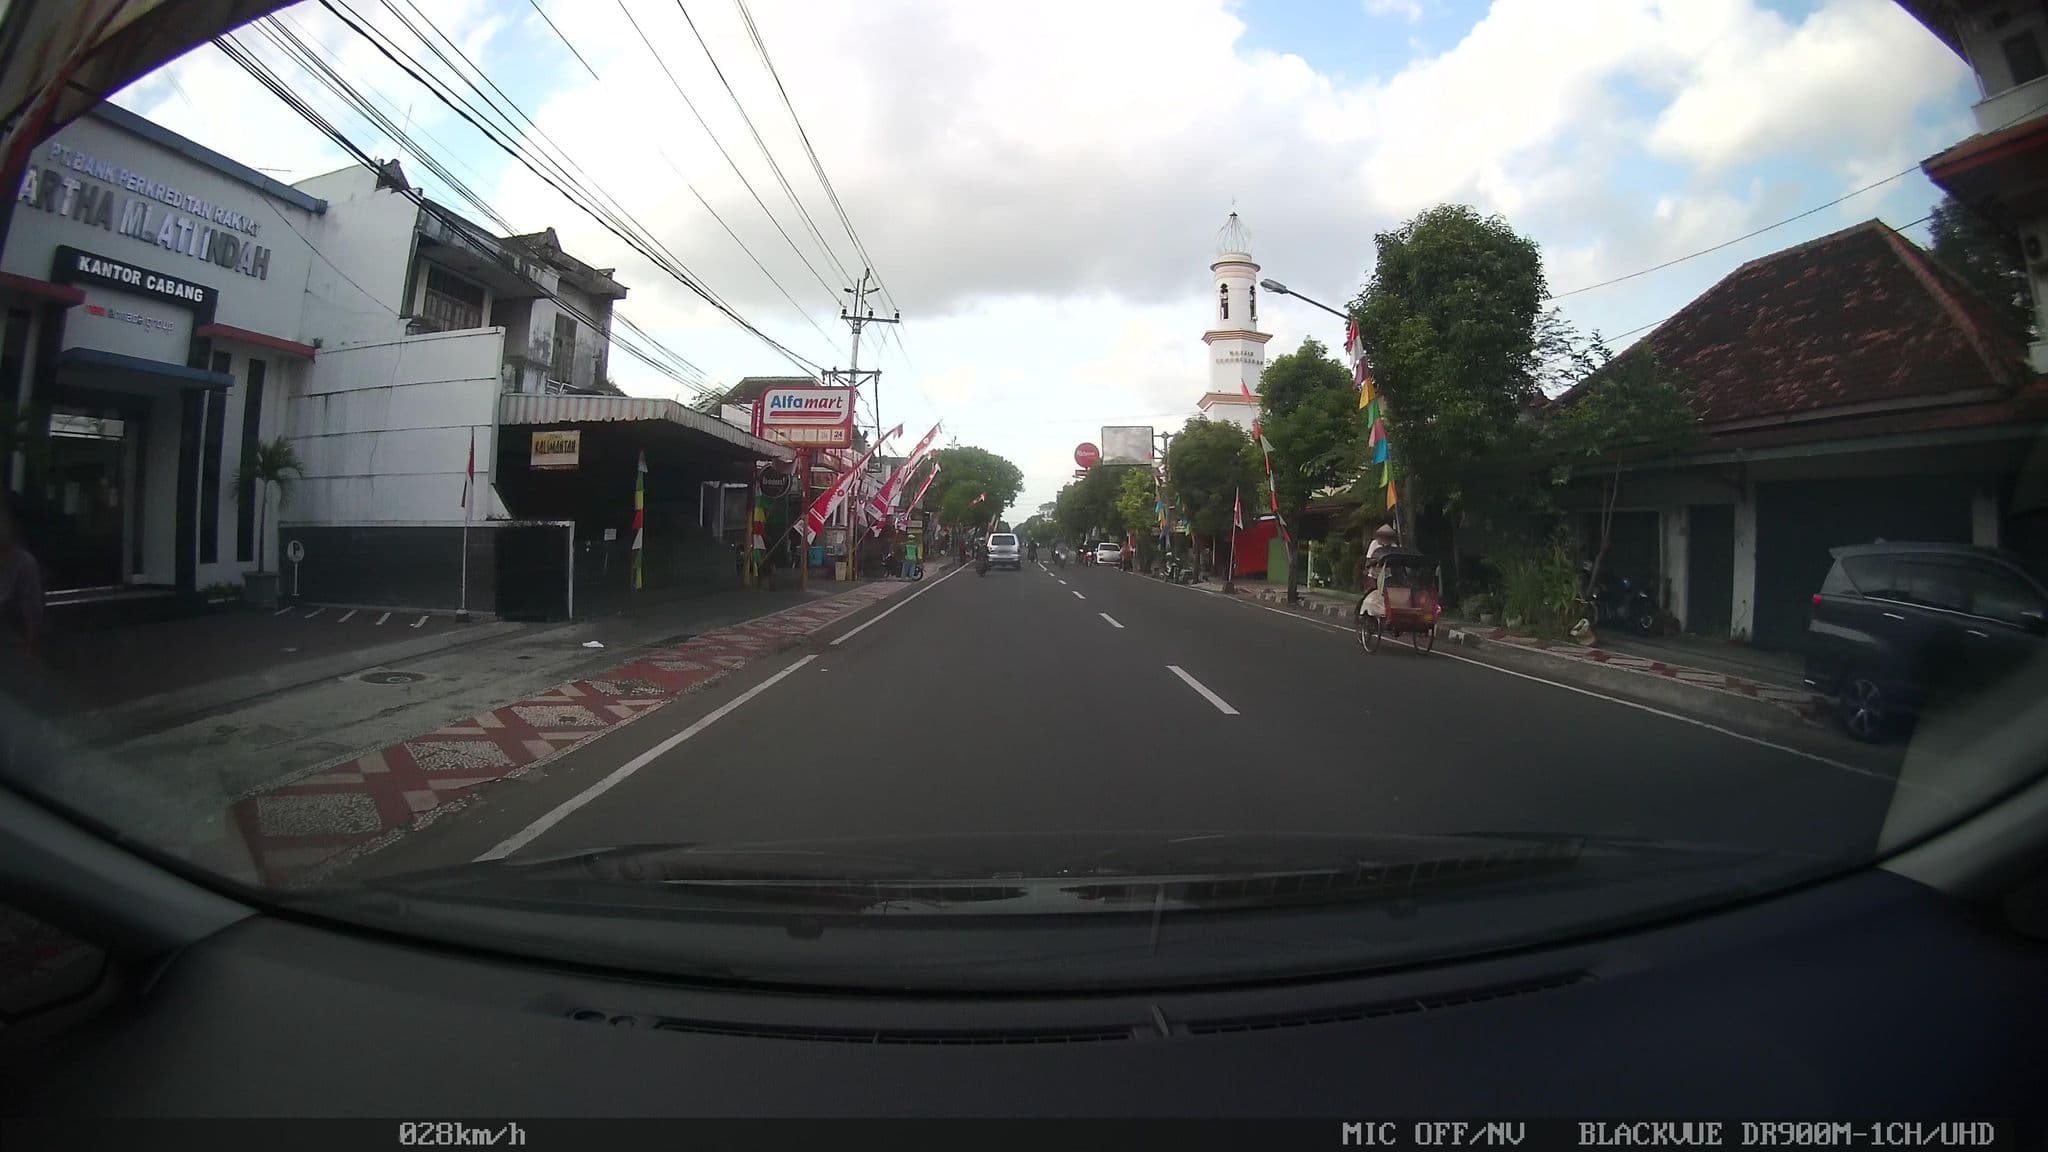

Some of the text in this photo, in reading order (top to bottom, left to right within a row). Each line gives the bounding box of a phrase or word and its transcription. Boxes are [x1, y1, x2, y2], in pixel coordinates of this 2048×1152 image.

[71, 151, 114, 185] BANK
[116, 167, 211, 220] PERKREDITAN
[213, 205, 261, 238] RAKYAT
[17, 165, 271, 281] ARTHA MLATI INDAH
[79, 256, 204, 302] KANTOR CABANG
[770, 395, 843, 409] Alfamart
[535, 439, 576, 455] KALIMANTAN
